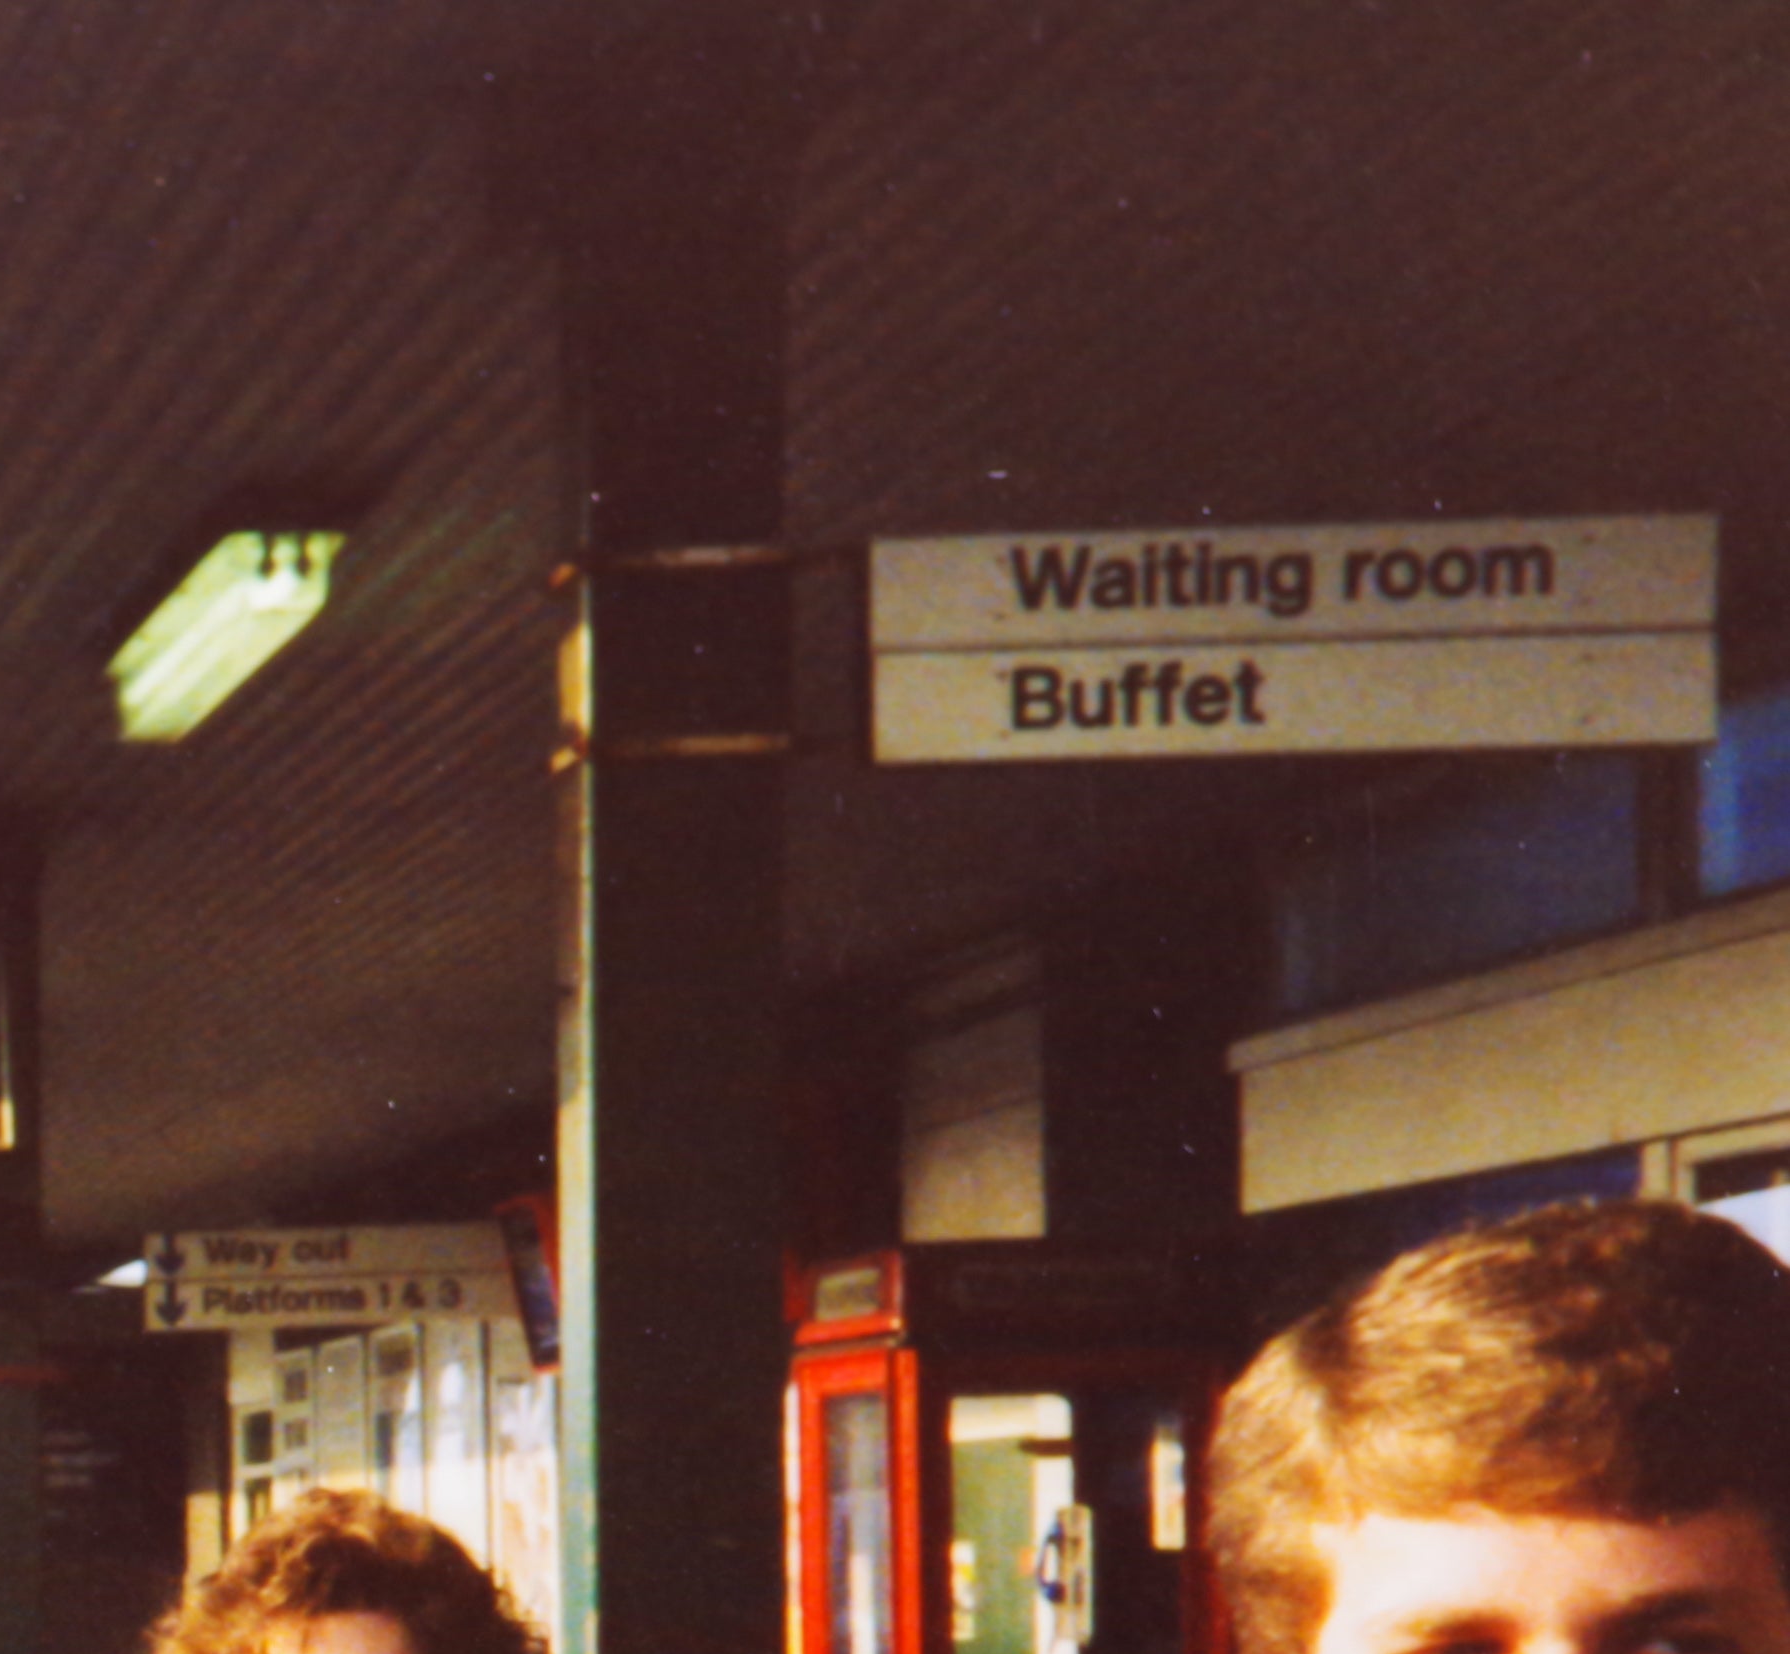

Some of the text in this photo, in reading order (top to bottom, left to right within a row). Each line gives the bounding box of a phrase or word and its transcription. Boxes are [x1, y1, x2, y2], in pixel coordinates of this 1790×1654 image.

[1009, 542, 1555, 618] Waiting room
[1011, 662, 1264, 730] Buffet
[204, 1233, 349, 1267] Way out
[205, 1285, 364, 1313] Platforms
[379, 1283, 390, 1309] 1
[438, 1279, 462, 1309] 3
